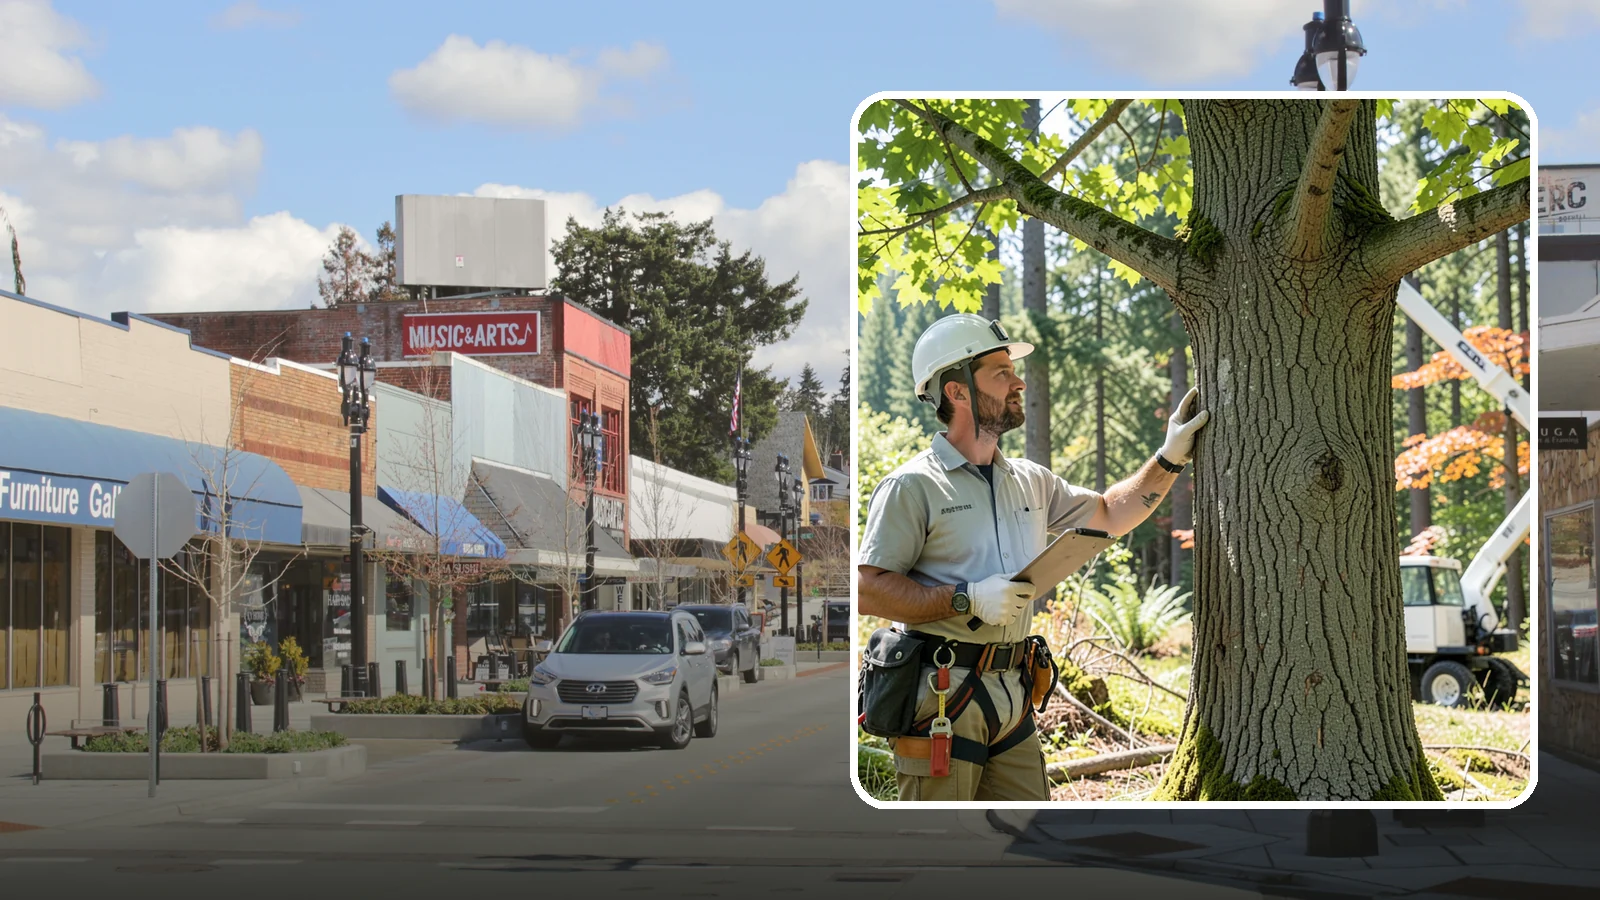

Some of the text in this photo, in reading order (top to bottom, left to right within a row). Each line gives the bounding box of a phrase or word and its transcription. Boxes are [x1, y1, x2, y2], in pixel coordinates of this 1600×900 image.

[409, 323, 519, 348] MUSIC&ARTS
[0, 471, 79, 515] Furniture
[453, 563, 479, 574] SUSHI
